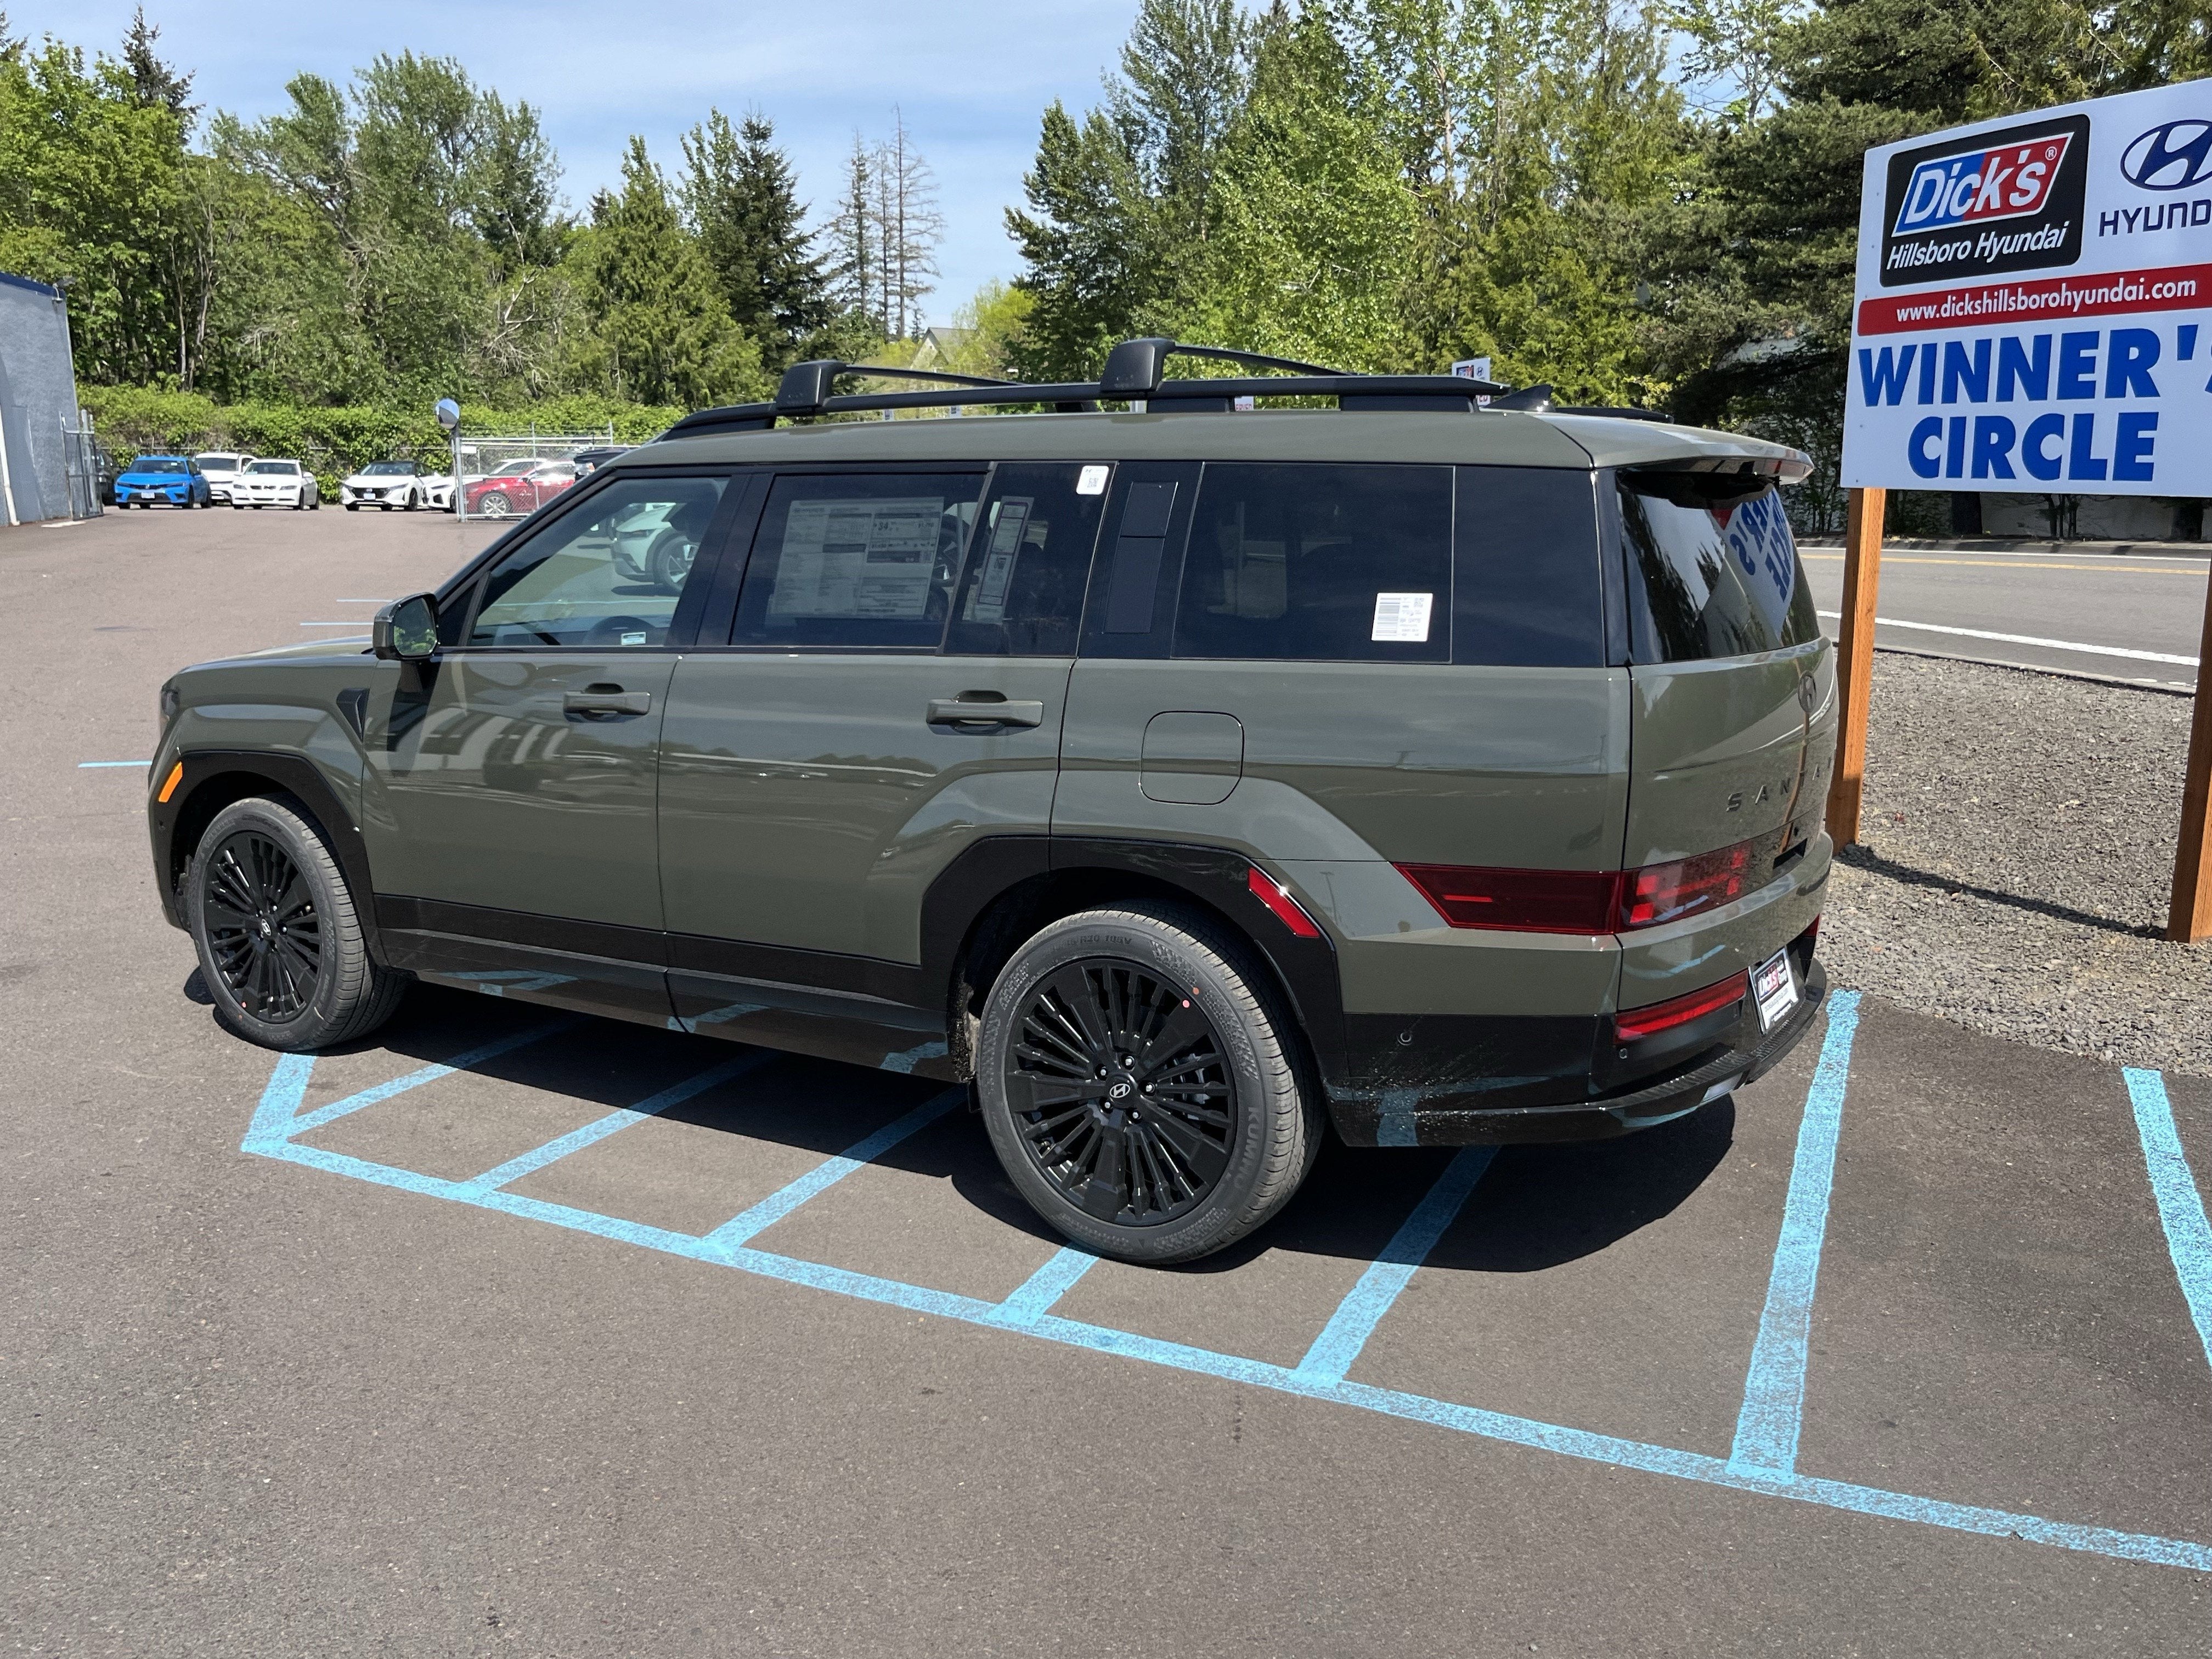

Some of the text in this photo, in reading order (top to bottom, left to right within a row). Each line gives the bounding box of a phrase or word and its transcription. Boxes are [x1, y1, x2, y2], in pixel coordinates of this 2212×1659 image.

[2099, 199, 2212, 236] HYUND
[1887, 221, 2069, 270] Hillsboro Hyundai
[1897, 278, 2196, 323] www.dickshillsborohyundai.com
[1908, 411, 2159, 481] CIRCLE
